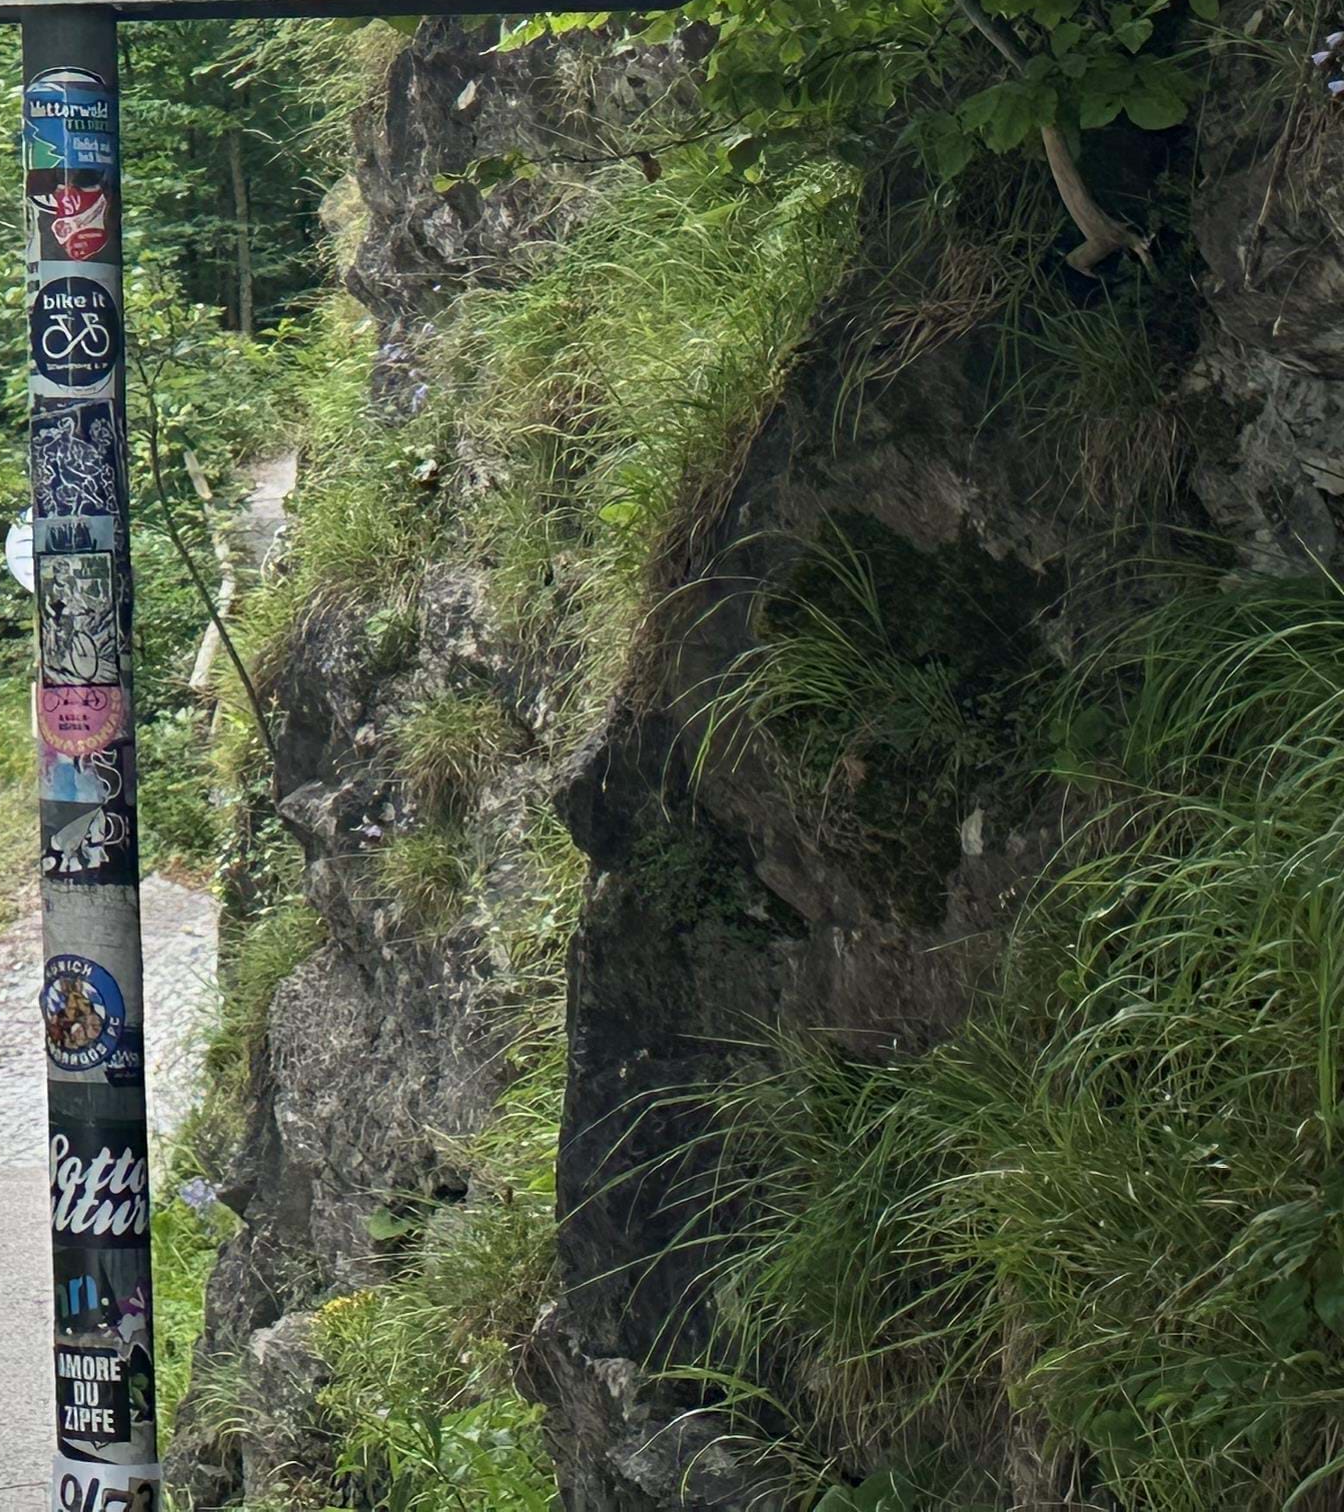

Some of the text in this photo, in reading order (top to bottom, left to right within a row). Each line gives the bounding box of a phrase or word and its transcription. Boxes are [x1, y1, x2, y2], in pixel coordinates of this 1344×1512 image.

[61, 194, 81, 215] SV
[43, 291, 106, 310] bike it
[74, 1381, 99, 1406] DU
[64, 1407, 116, 1434] ZIPFE
